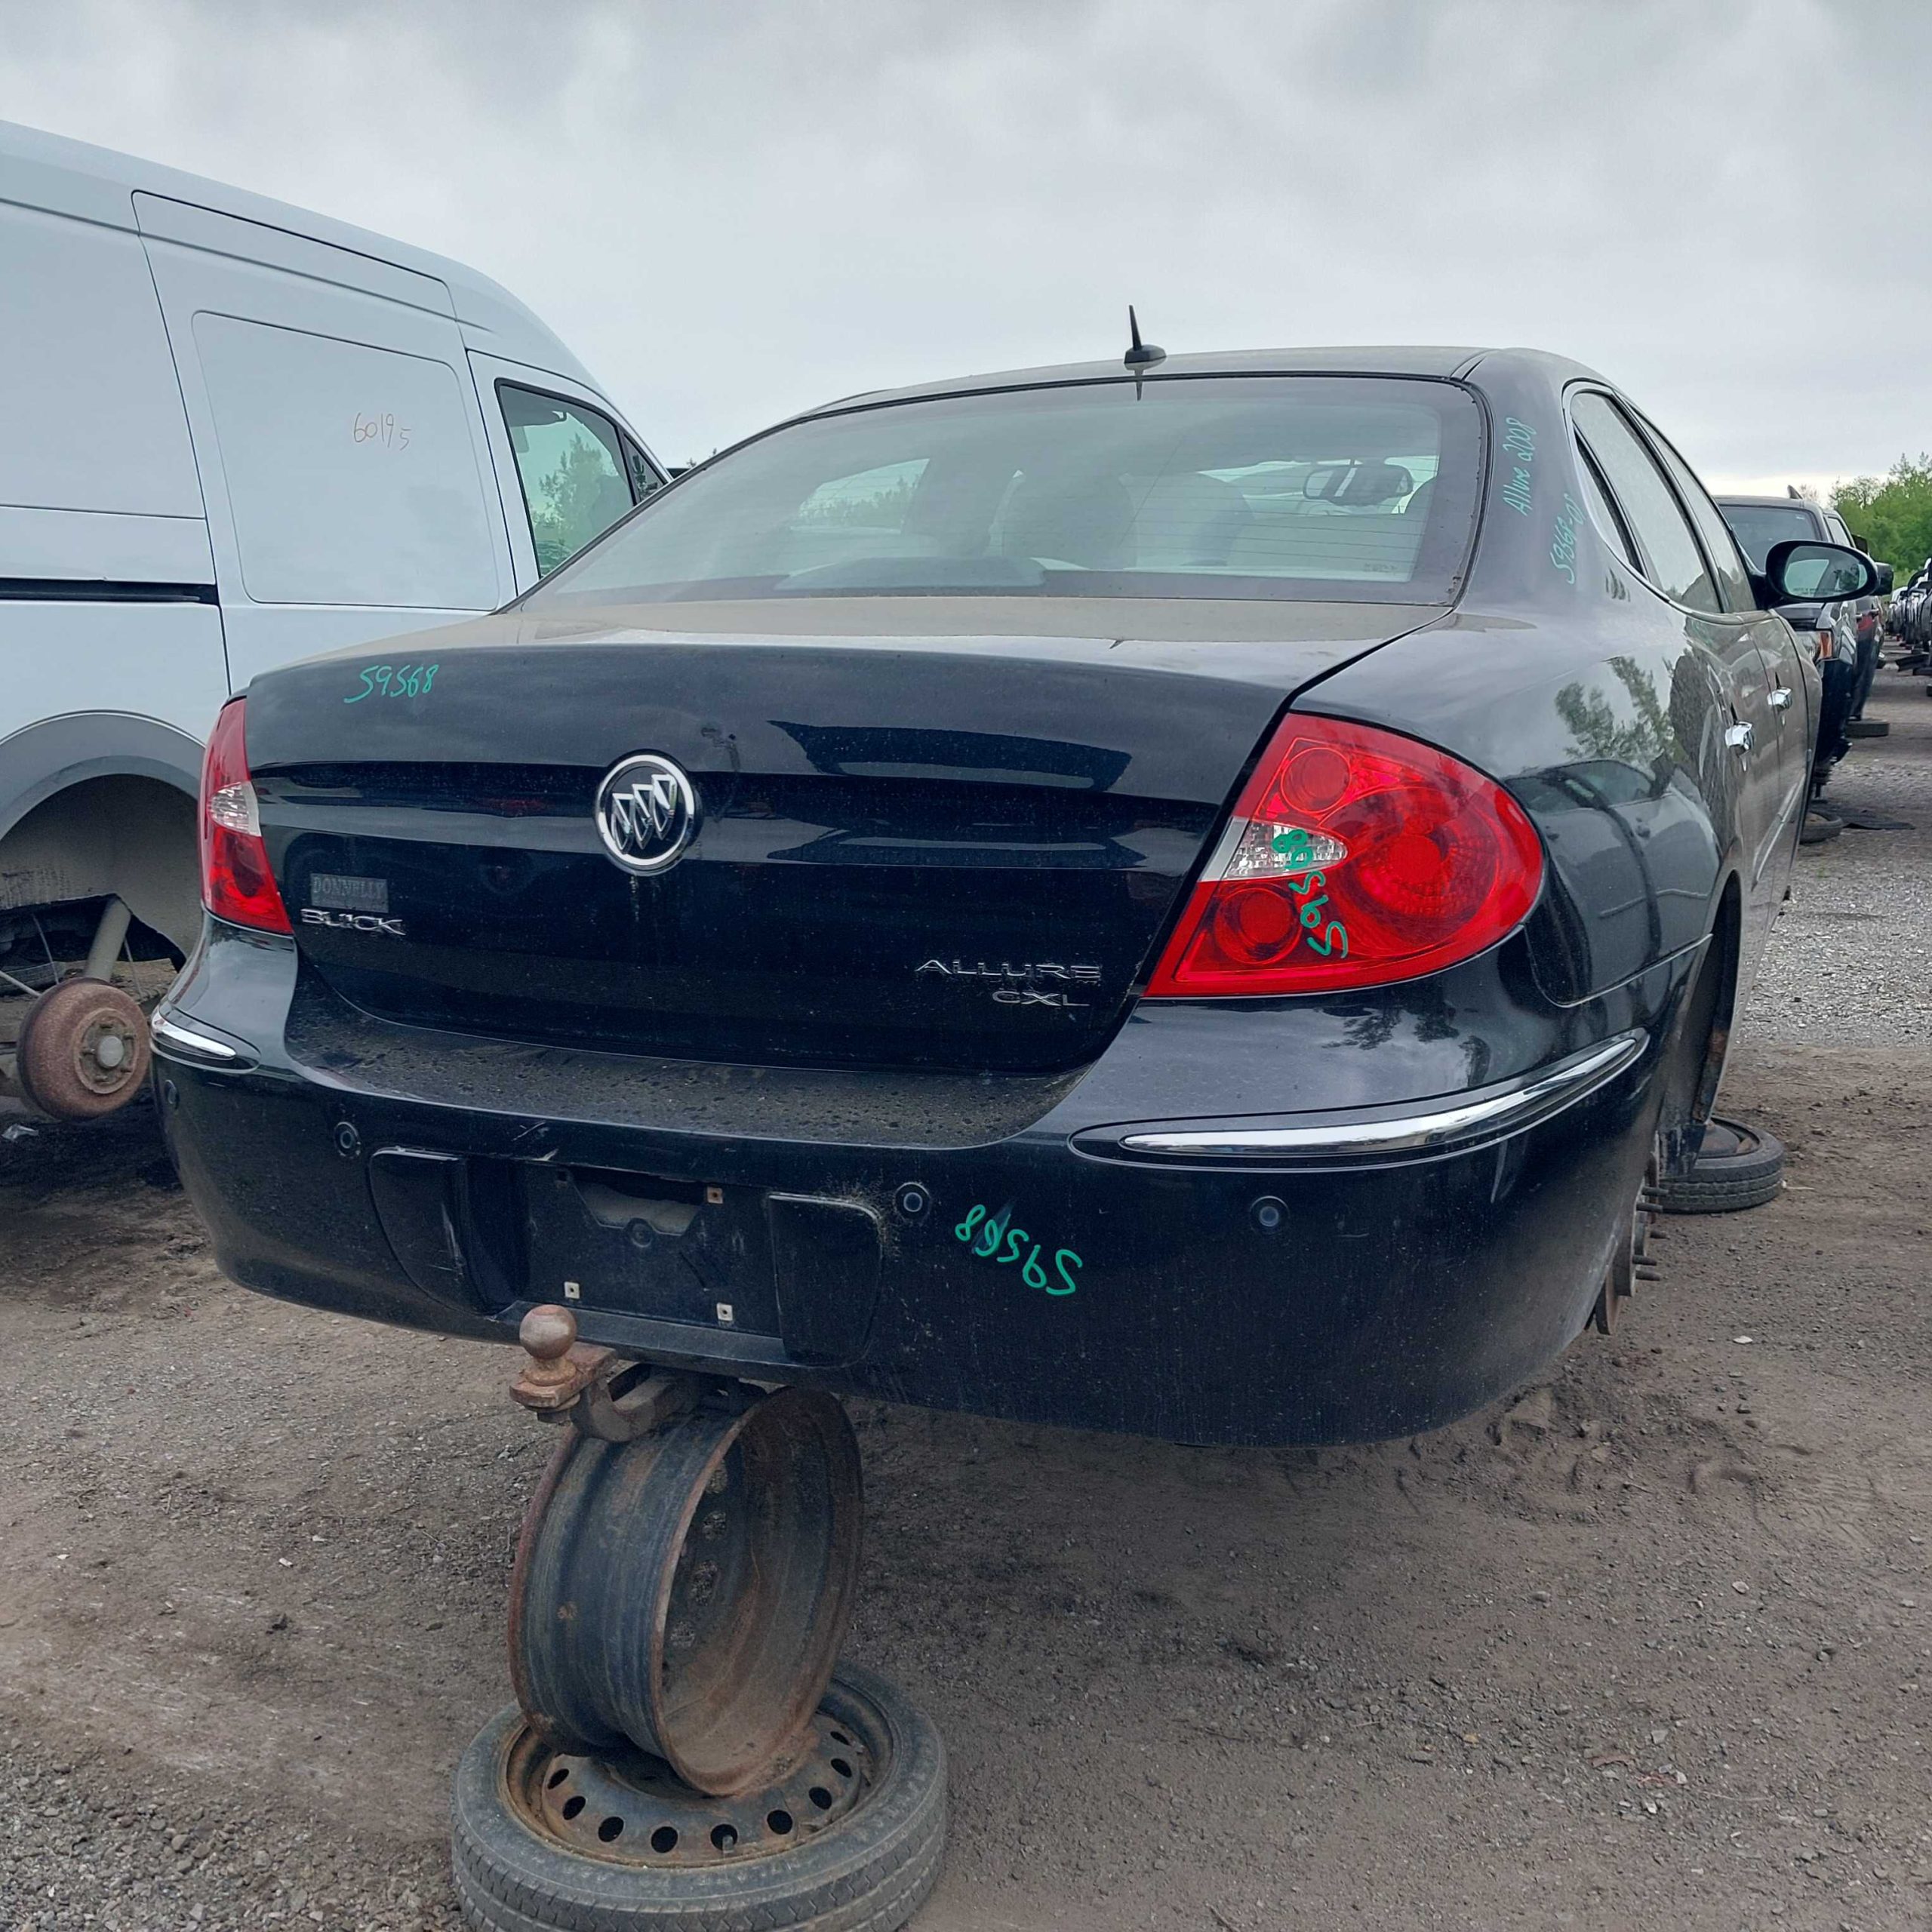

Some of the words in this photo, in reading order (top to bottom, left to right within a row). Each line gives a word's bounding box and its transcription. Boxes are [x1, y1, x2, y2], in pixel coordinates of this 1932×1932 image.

[353, 412, 411, 451] 60195
[1503, 417, 1537, 462] 2008
[1503, 466, 1533, 516] Allure
[343, 664, 438, 703] 59568
[1272, 829, 1349, 958] 59568
[300, 908, 406, 935] BUICK
[914, 959, 1100, 980] ALLURE
[992, 990, 1090, 1007] CXL
[955, 1204, 1083, 1295] 59568
